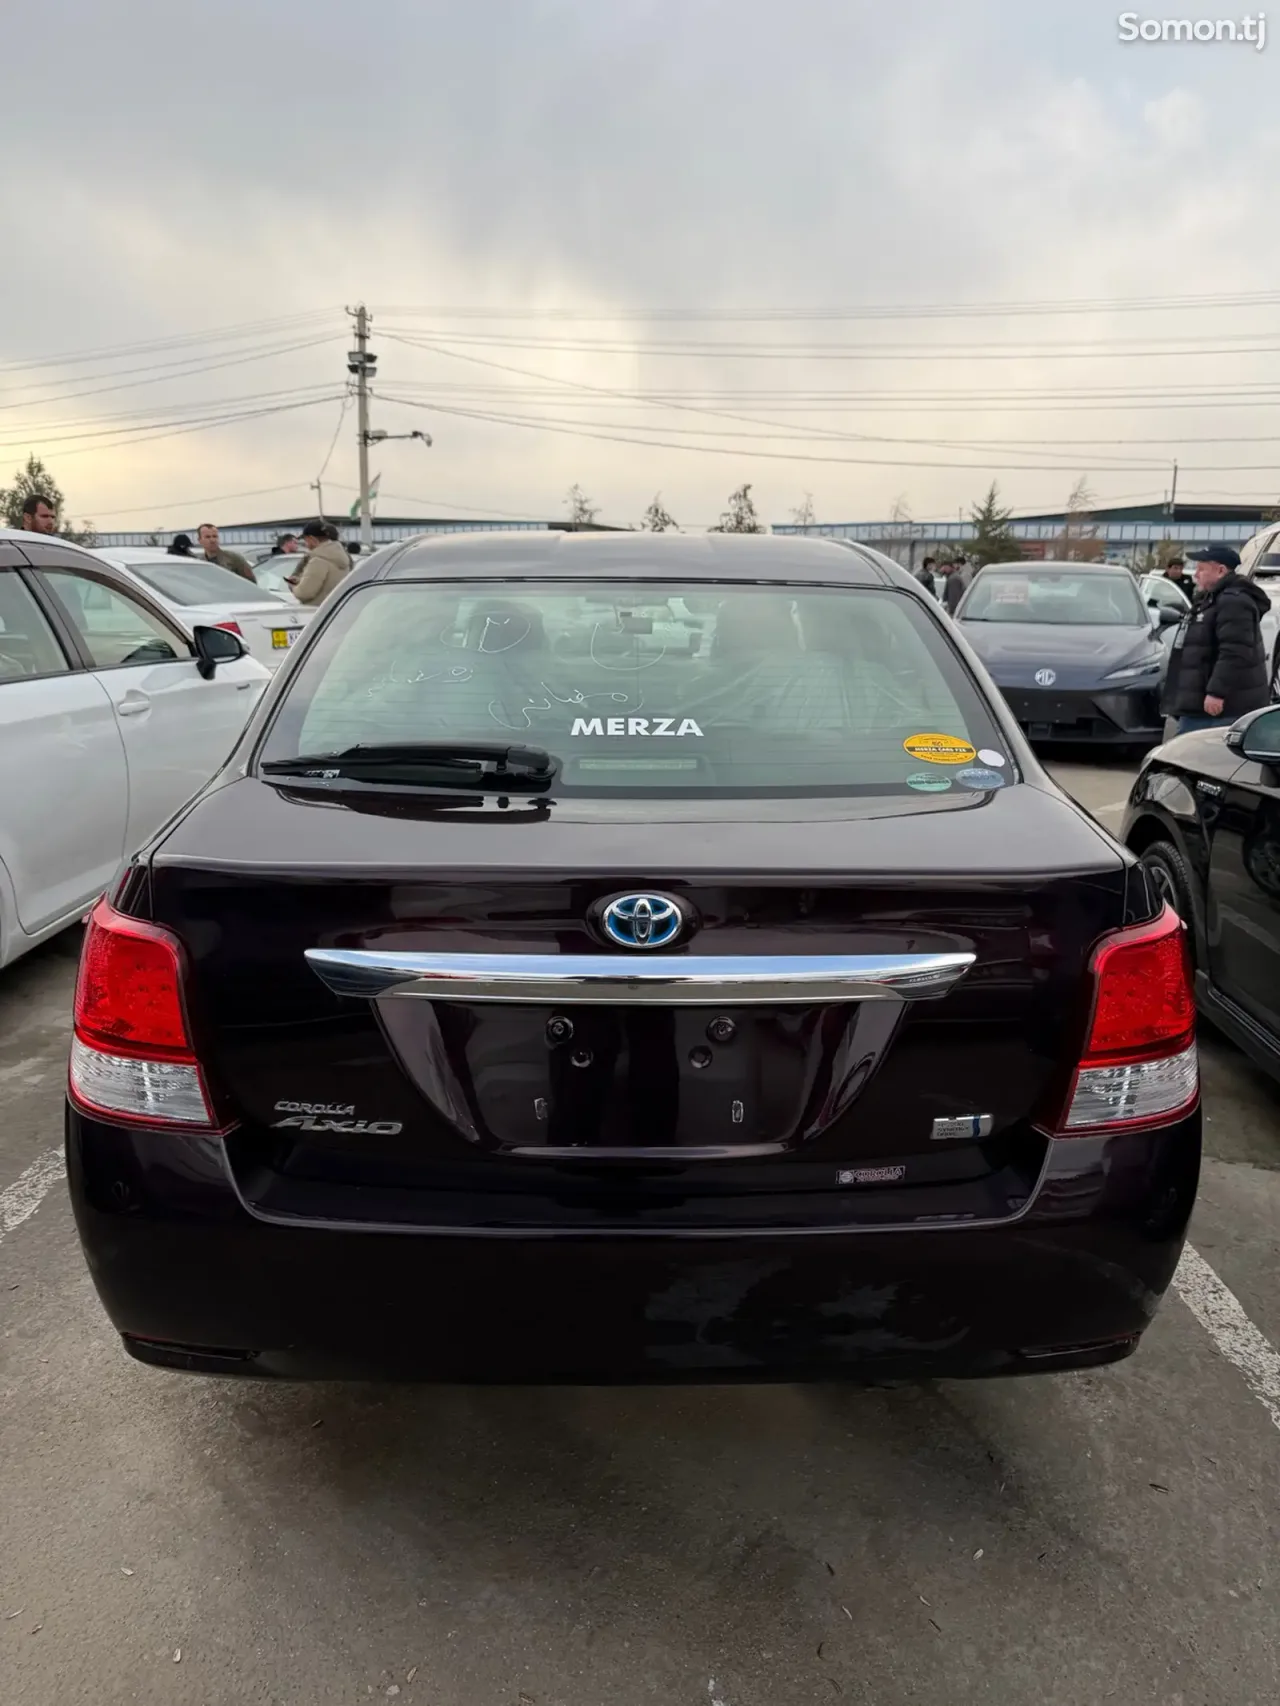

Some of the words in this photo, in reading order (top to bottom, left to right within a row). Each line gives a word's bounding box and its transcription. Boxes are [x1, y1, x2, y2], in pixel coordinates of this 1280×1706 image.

[1035, 668, 1056, 687] MG
[570, 718, 705, 737] MERZA
[274, 1100, 355, 1115] COROLLA
